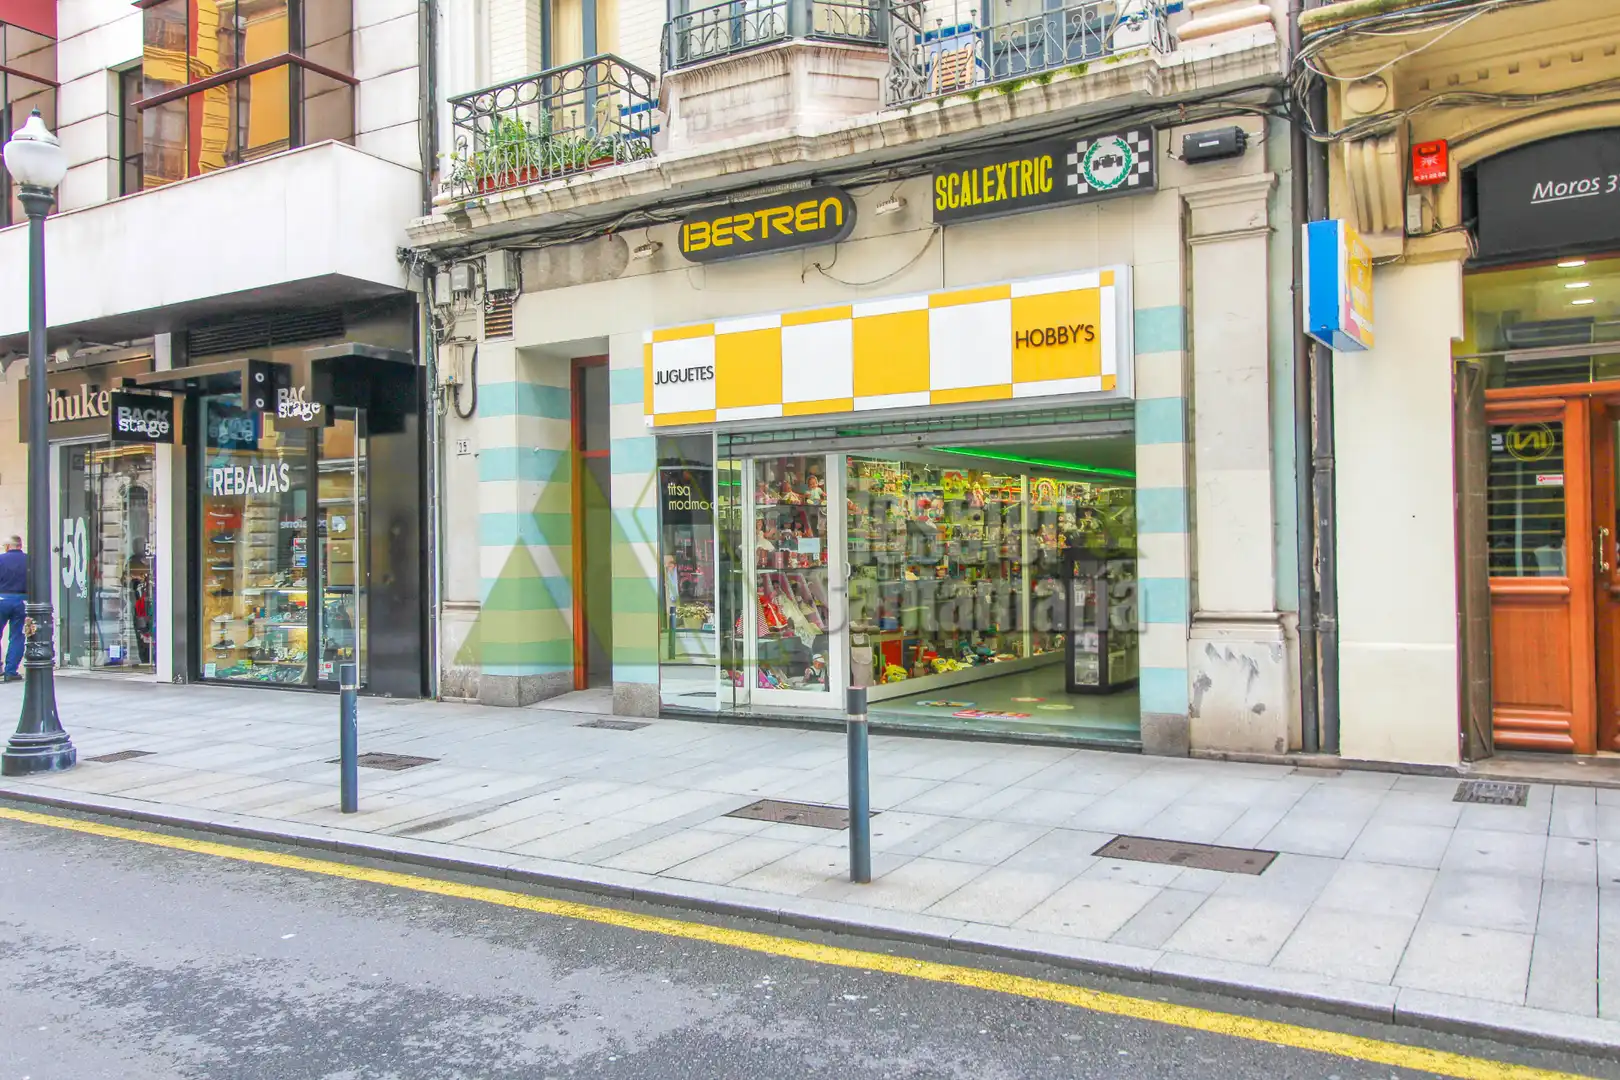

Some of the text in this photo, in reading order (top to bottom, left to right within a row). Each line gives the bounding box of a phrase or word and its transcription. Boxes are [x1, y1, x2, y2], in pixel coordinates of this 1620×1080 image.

[935, 154, 1053, 212] SCALEXTRIC
[1532, 174, 1620, 200] Moros 3
[1015, 323, 1096, 350] HOBBY'S
[654, 365, 715, 386] JUGUETES
[47, 383, 120, 423] huke
[118, 406, 169, 424] BACK
[278, 397, 321, 422] stage
[118, 415, 169, 438] stage
[212, 463, 290, 496] REBAJAS
[62, 517, 86, 589] 50
